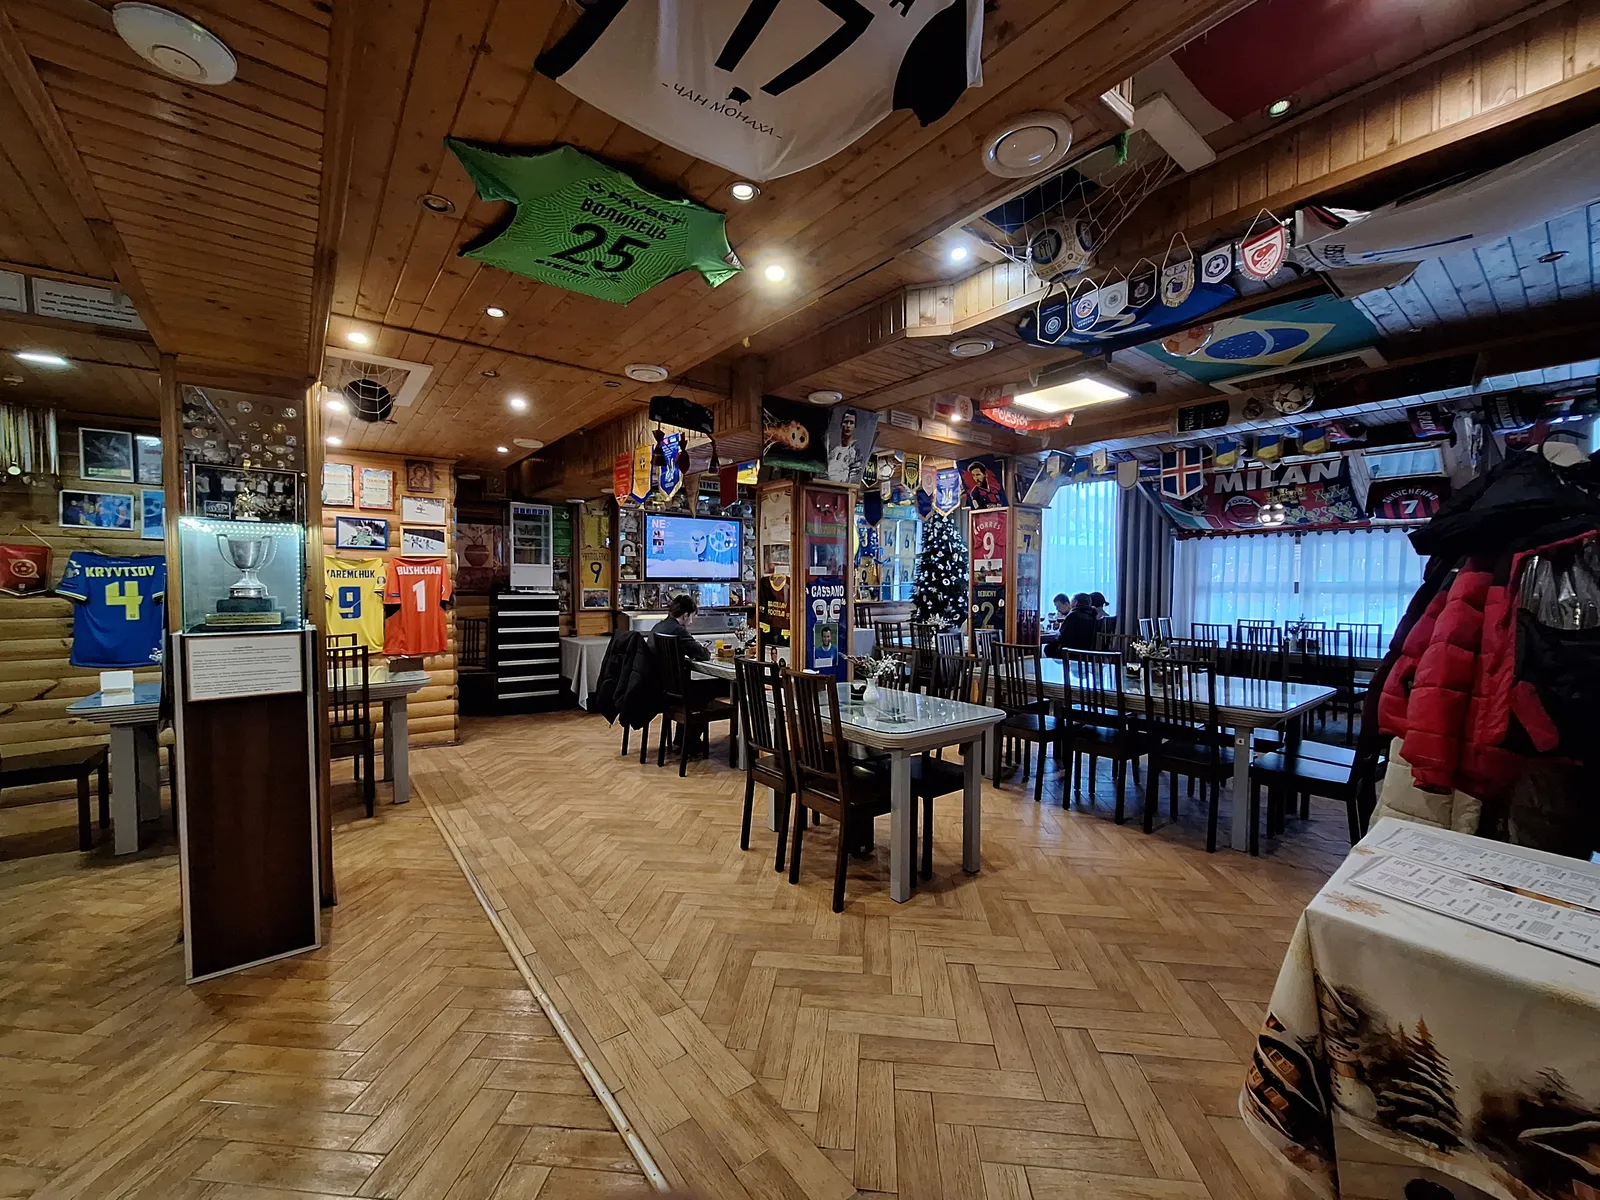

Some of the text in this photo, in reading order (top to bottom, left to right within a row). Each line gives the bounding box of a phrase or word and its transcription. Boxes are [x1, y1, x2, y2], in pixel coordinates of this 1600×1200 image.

[673, 82, 774, 136] ЧАН МОНАХА
[580, 197, 668, 241] ВОЛИНЕЦЬ
[607, 191, 683, 225] FAVBET
[549, 222, 652, 273] 25
[1213, 460, 1342, 494] MILAN
[1402, 500, 1419, 514] 7
[884, 531, 893, 547] 14
[904, 533, 910, 549] 6
[977, 521, 1001, 533] TORRES
[983, 532, 995, 560] 9
[1023, 534, 1032, 553] 7
[85, 566, 155, 578] KRYVTSOV
[396, 565, 442, 576] BUSHCHAN
[590, 561, 602, 583] 9
[105, 581, 144, 621] 4
[338, 586, 361, 619] 9
[412, 579, 426, 613] 1
[811, 585, 845, 598] CASSANO
[980, 601, 995, 629] 2
